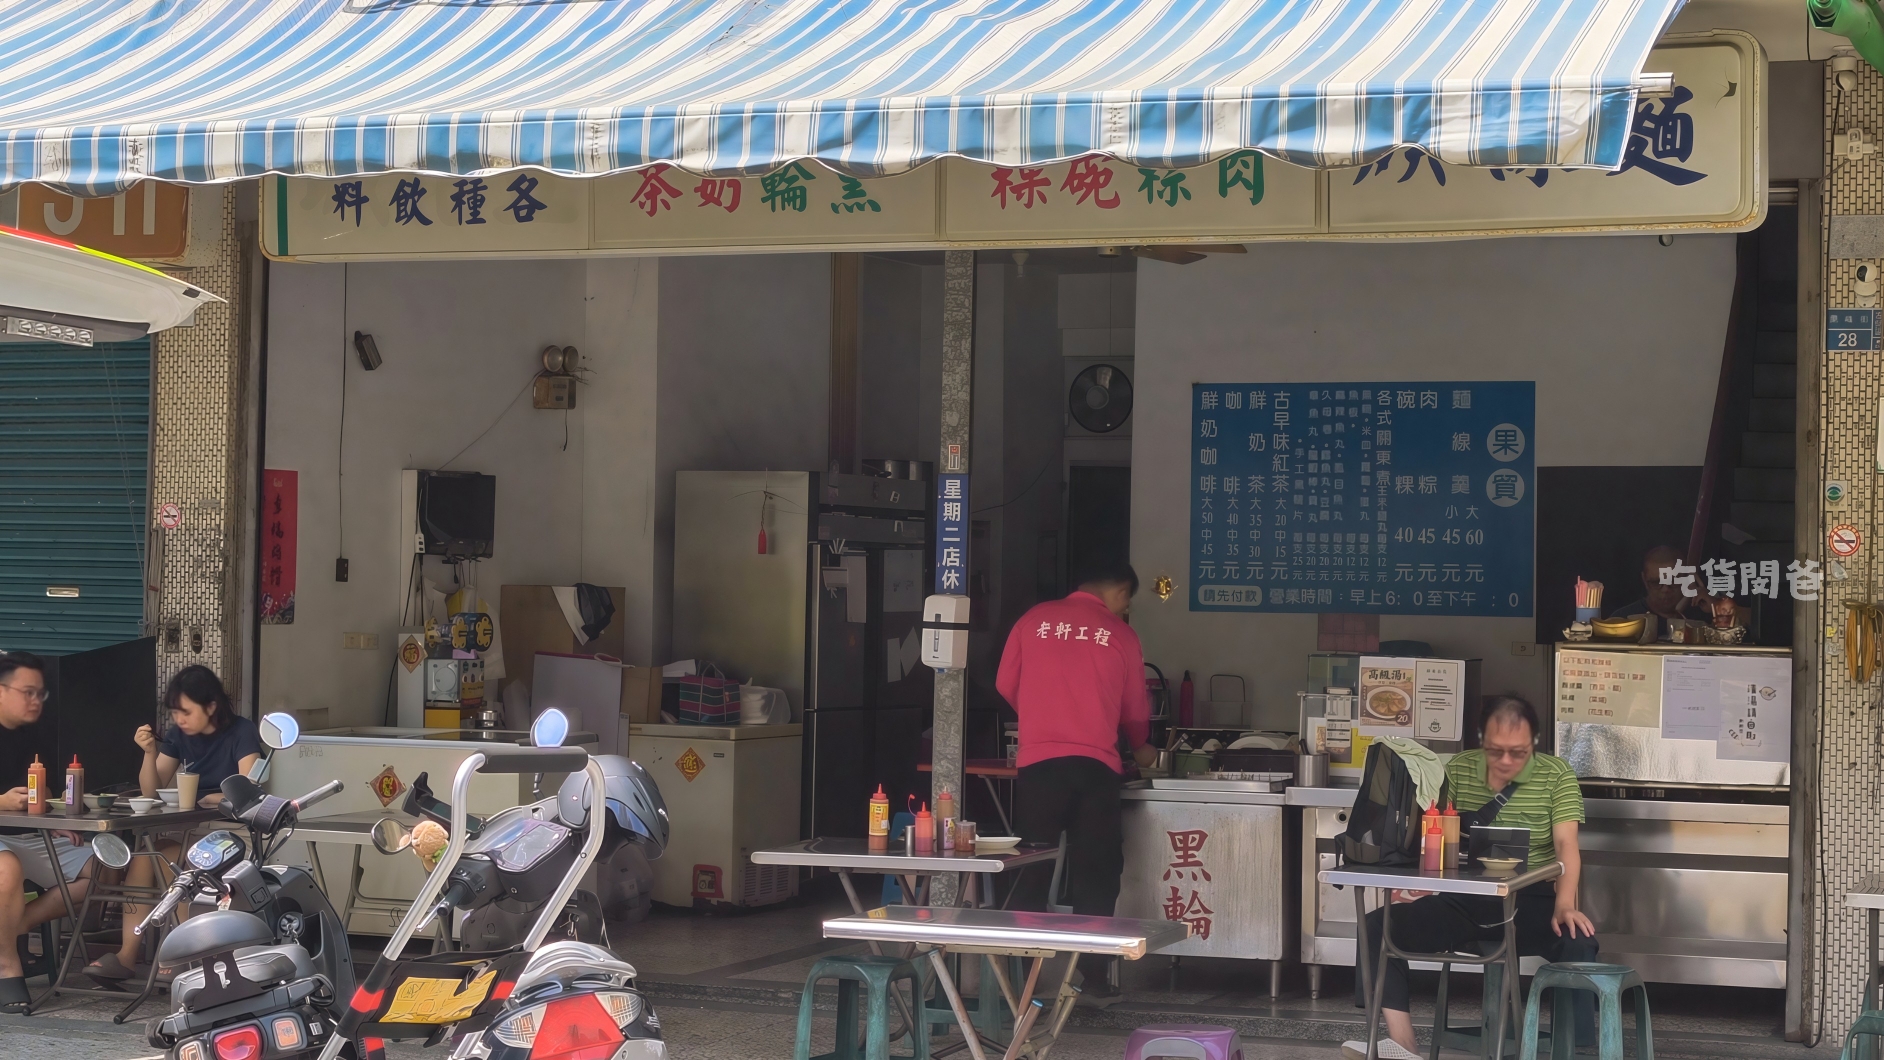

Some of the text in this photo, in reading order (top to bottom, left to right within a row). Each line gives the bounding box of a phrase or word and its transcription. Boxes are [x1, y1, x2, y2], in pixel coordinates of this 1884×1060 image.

[331, 173, 548, 228] 各種飲料
[1838, 332, 1857, 347] 28
[941, 479, 962, 590] 星期二店休
[1036, 621, 1111, 647] 老軒工程
[1162, 829, 1215, 940] 黑輪
